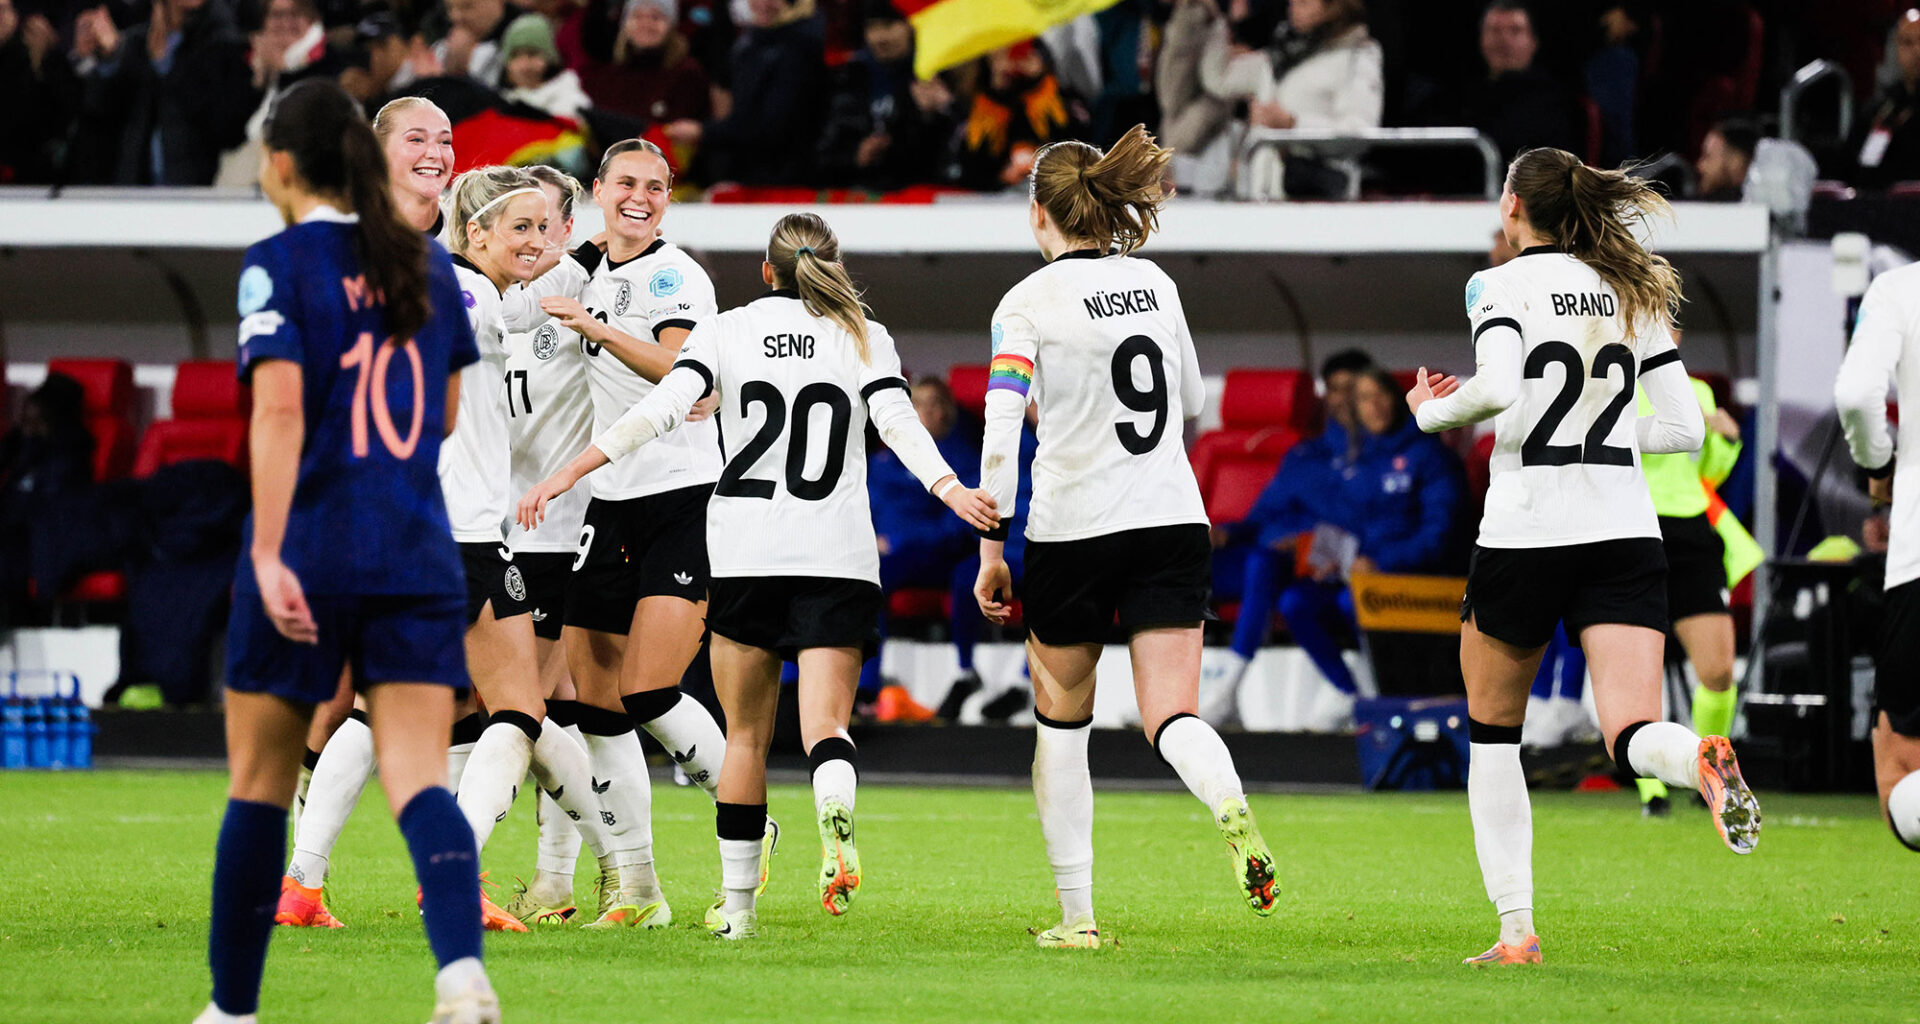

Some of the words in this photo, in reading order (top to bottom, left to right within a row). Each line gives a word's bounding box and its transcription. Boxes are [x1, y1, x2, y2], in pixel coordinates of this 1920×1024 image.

[1083, 288, 1160, 320] NÜSKEN
[1551, 292, 1616, 317] BRAND
[339, 332, 425, 460] 10
[504, 369, 533, 418] 17
[1111, 334, 1168, 455] 9
[1521, 340, 1635, 467] 22
[714, 380, 852, 501] 20
[571, 524, 596, 572] 9
